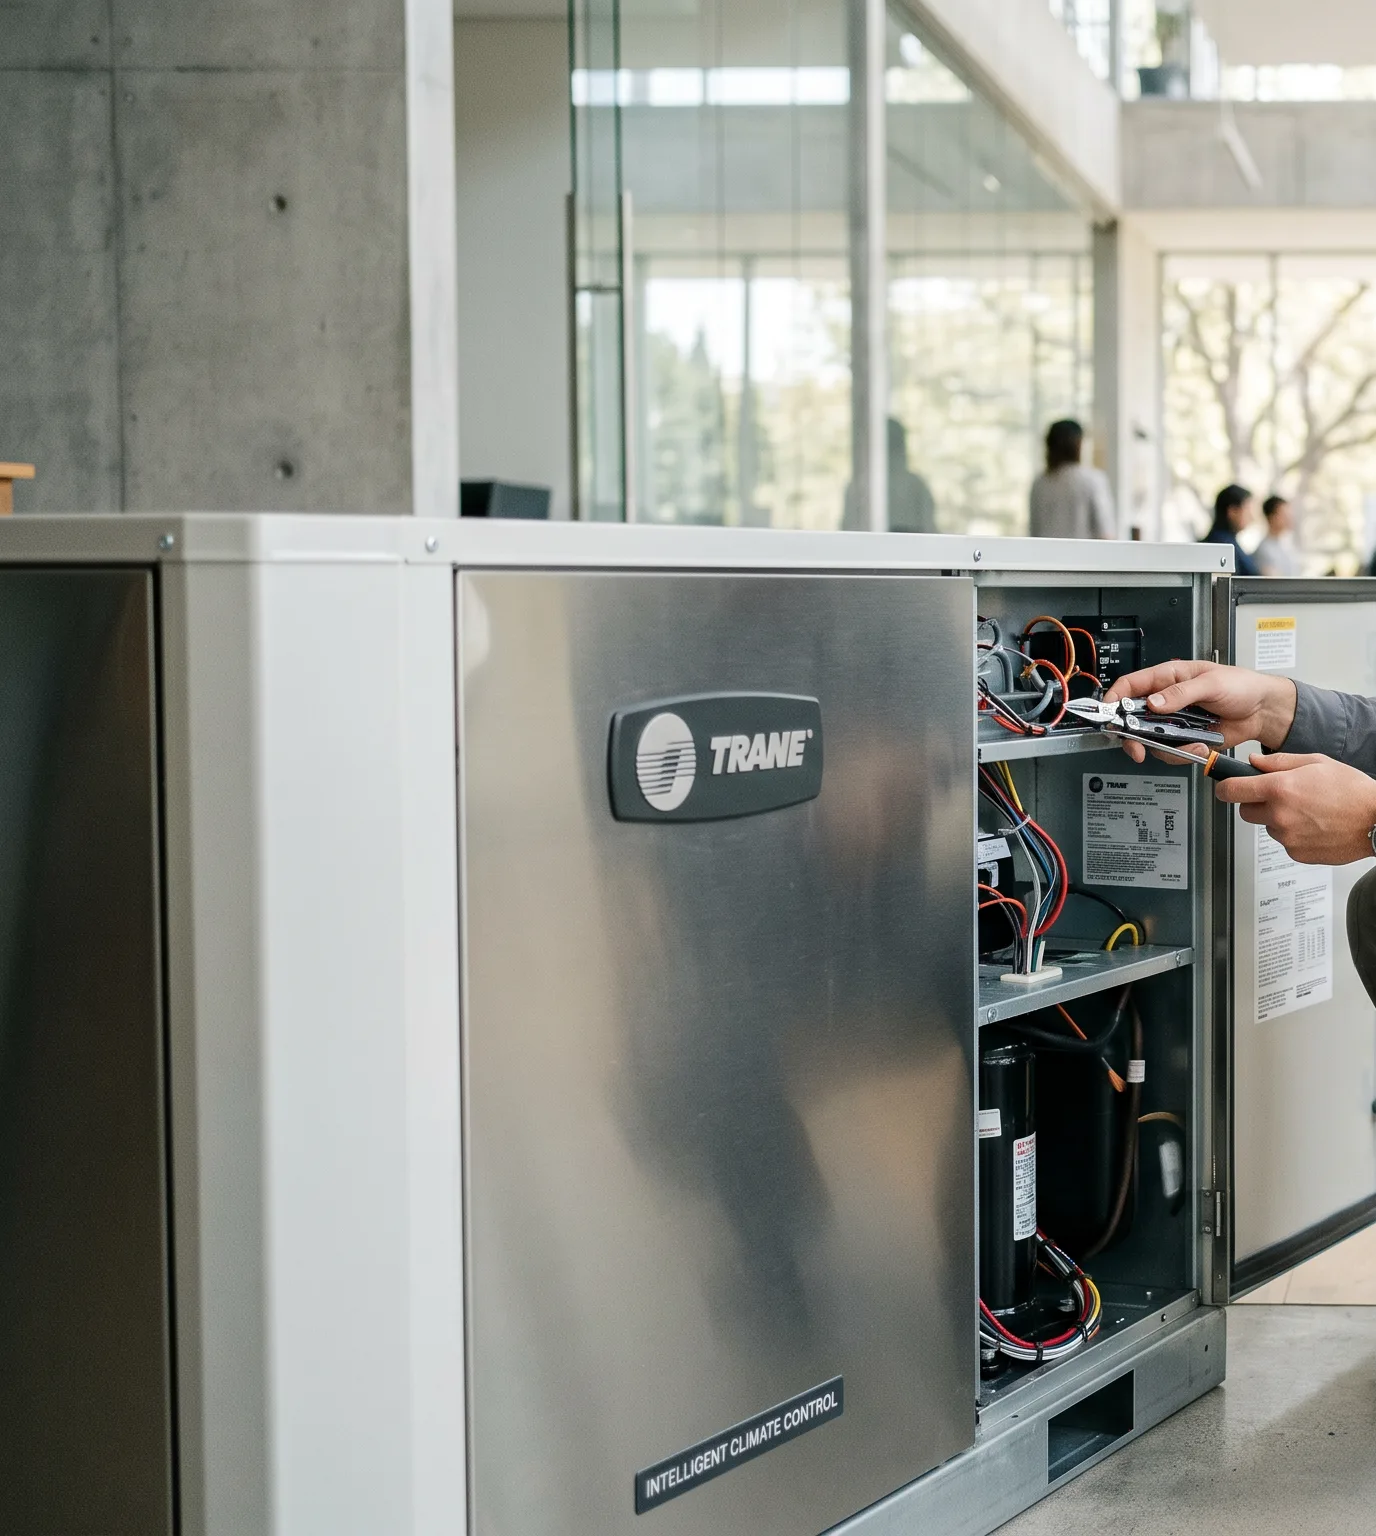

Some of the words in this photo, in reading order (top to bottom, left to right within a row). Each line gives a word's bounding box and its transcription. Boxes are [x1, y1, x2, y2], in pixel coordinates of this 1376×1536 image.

[710, 729, 807, 775] TRANE
[646, 1442, 729, 1498] INTELLIGENT
[730, 1417, 782, 1456] CLIMATE
[784, 1391, 838, 1431] CONTROL
